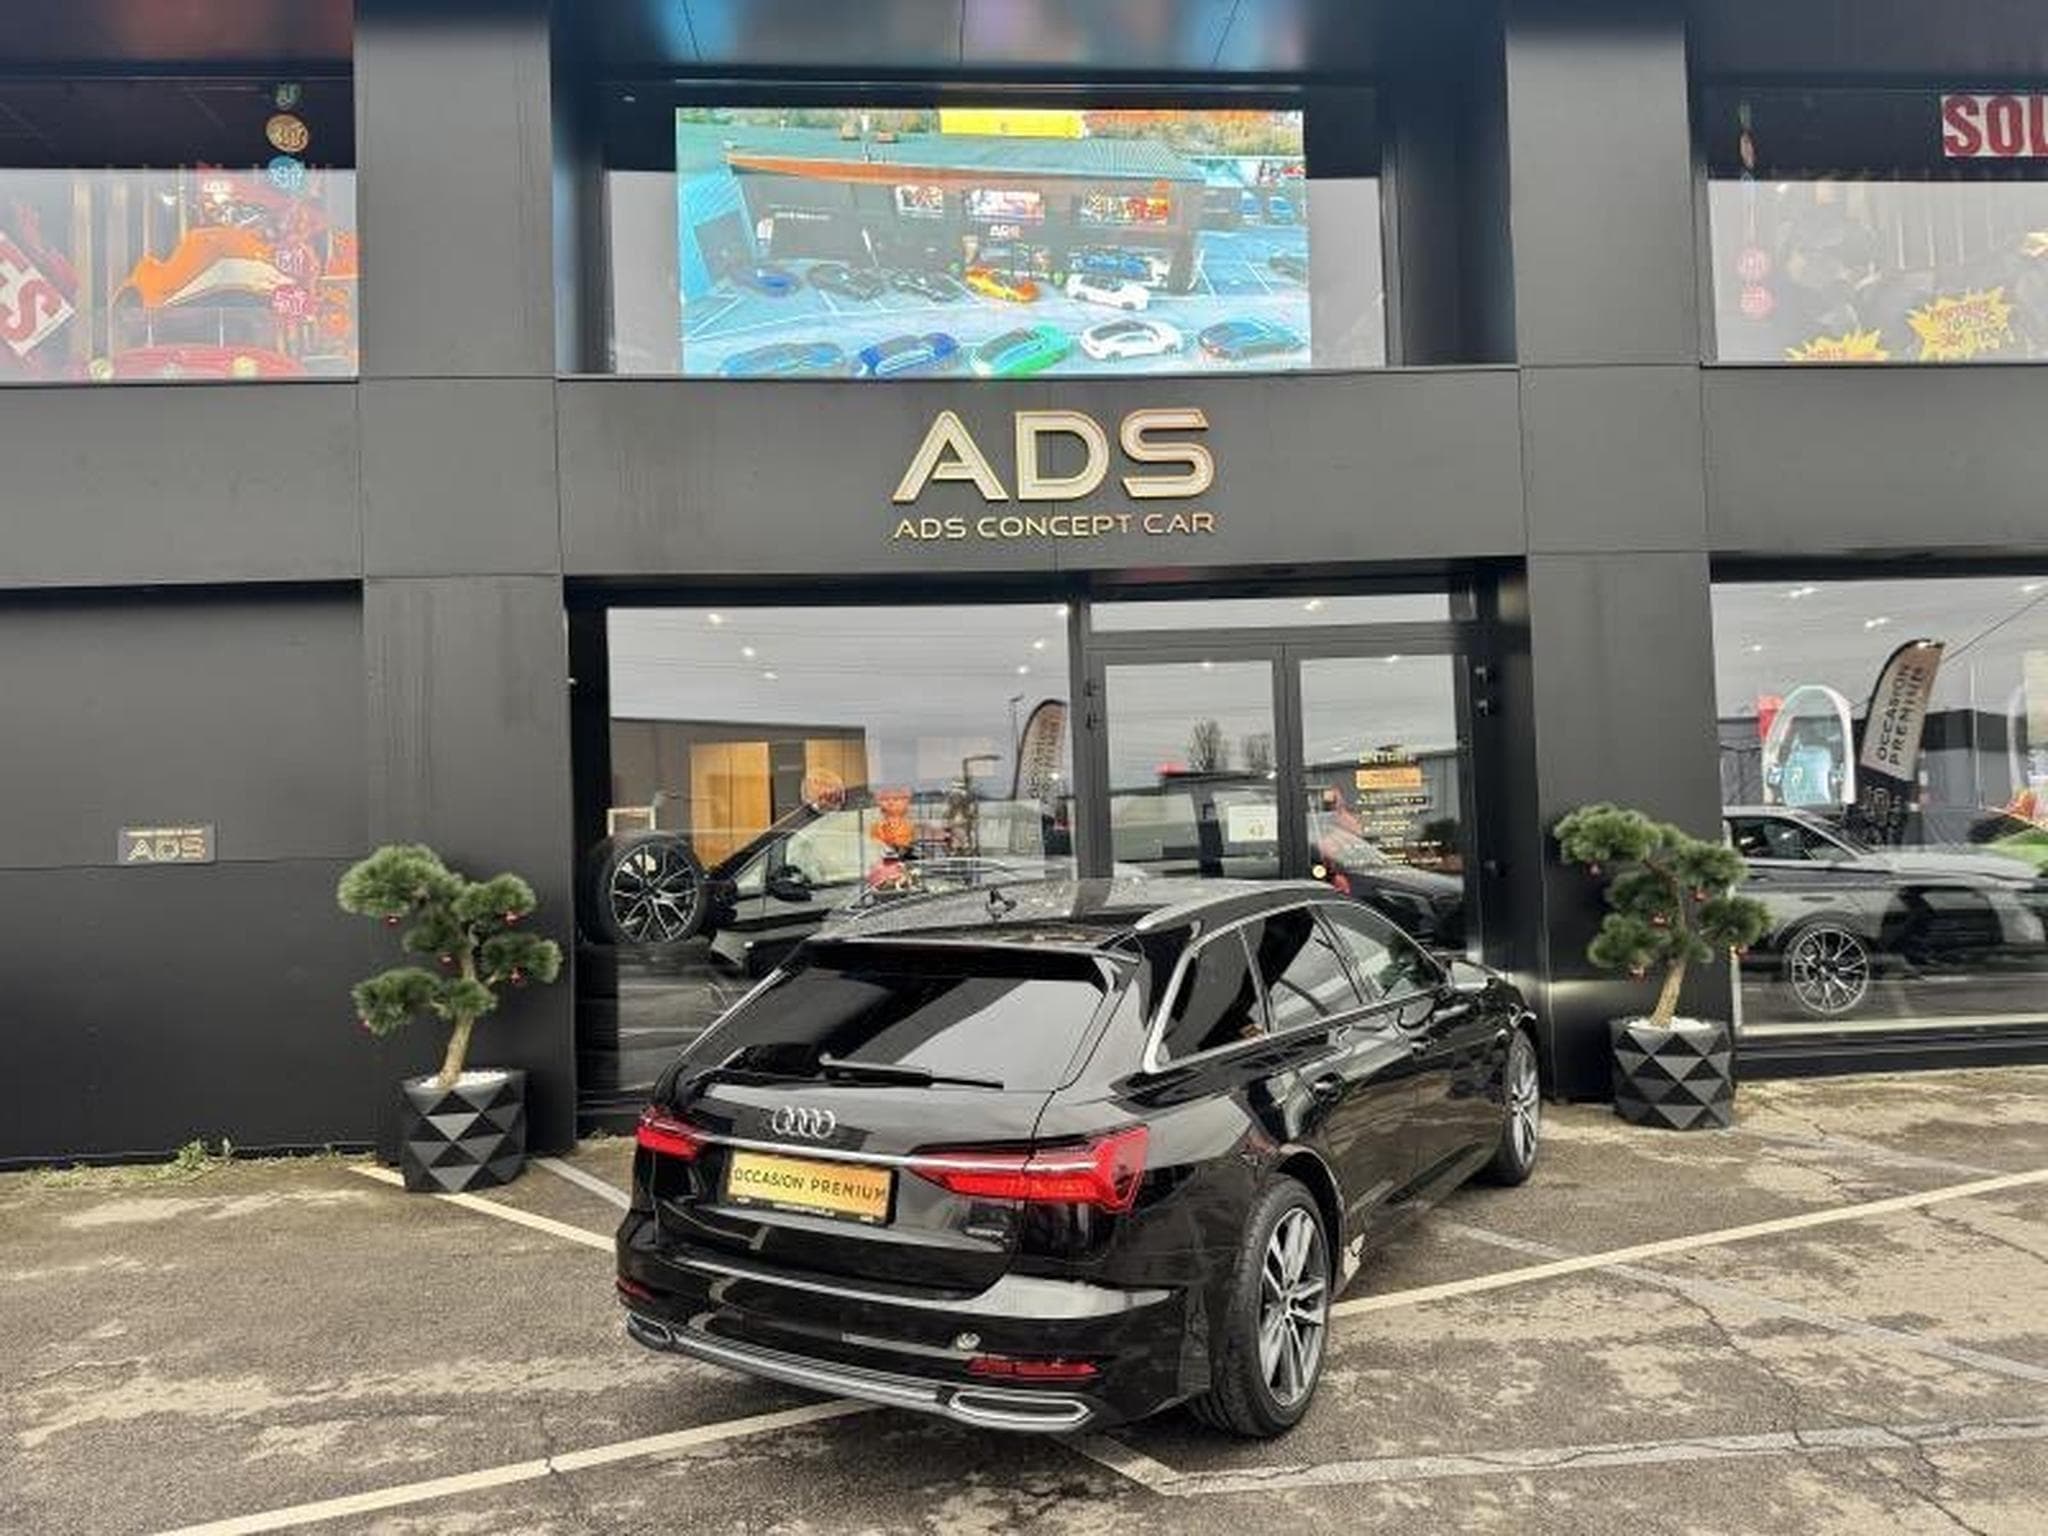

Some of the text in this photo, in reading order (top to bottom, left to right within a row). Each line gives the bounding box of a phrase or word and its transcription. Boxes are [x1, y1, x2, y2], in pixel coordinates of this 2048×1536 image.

[893, 409, 1215, 501] ADS
[894, 512, 1215, 540] ADS CONCEPT CAR
[127, 838, 206, 861] ADS
[734, 1167, 886, 1199] OCCASION PREMIUM
